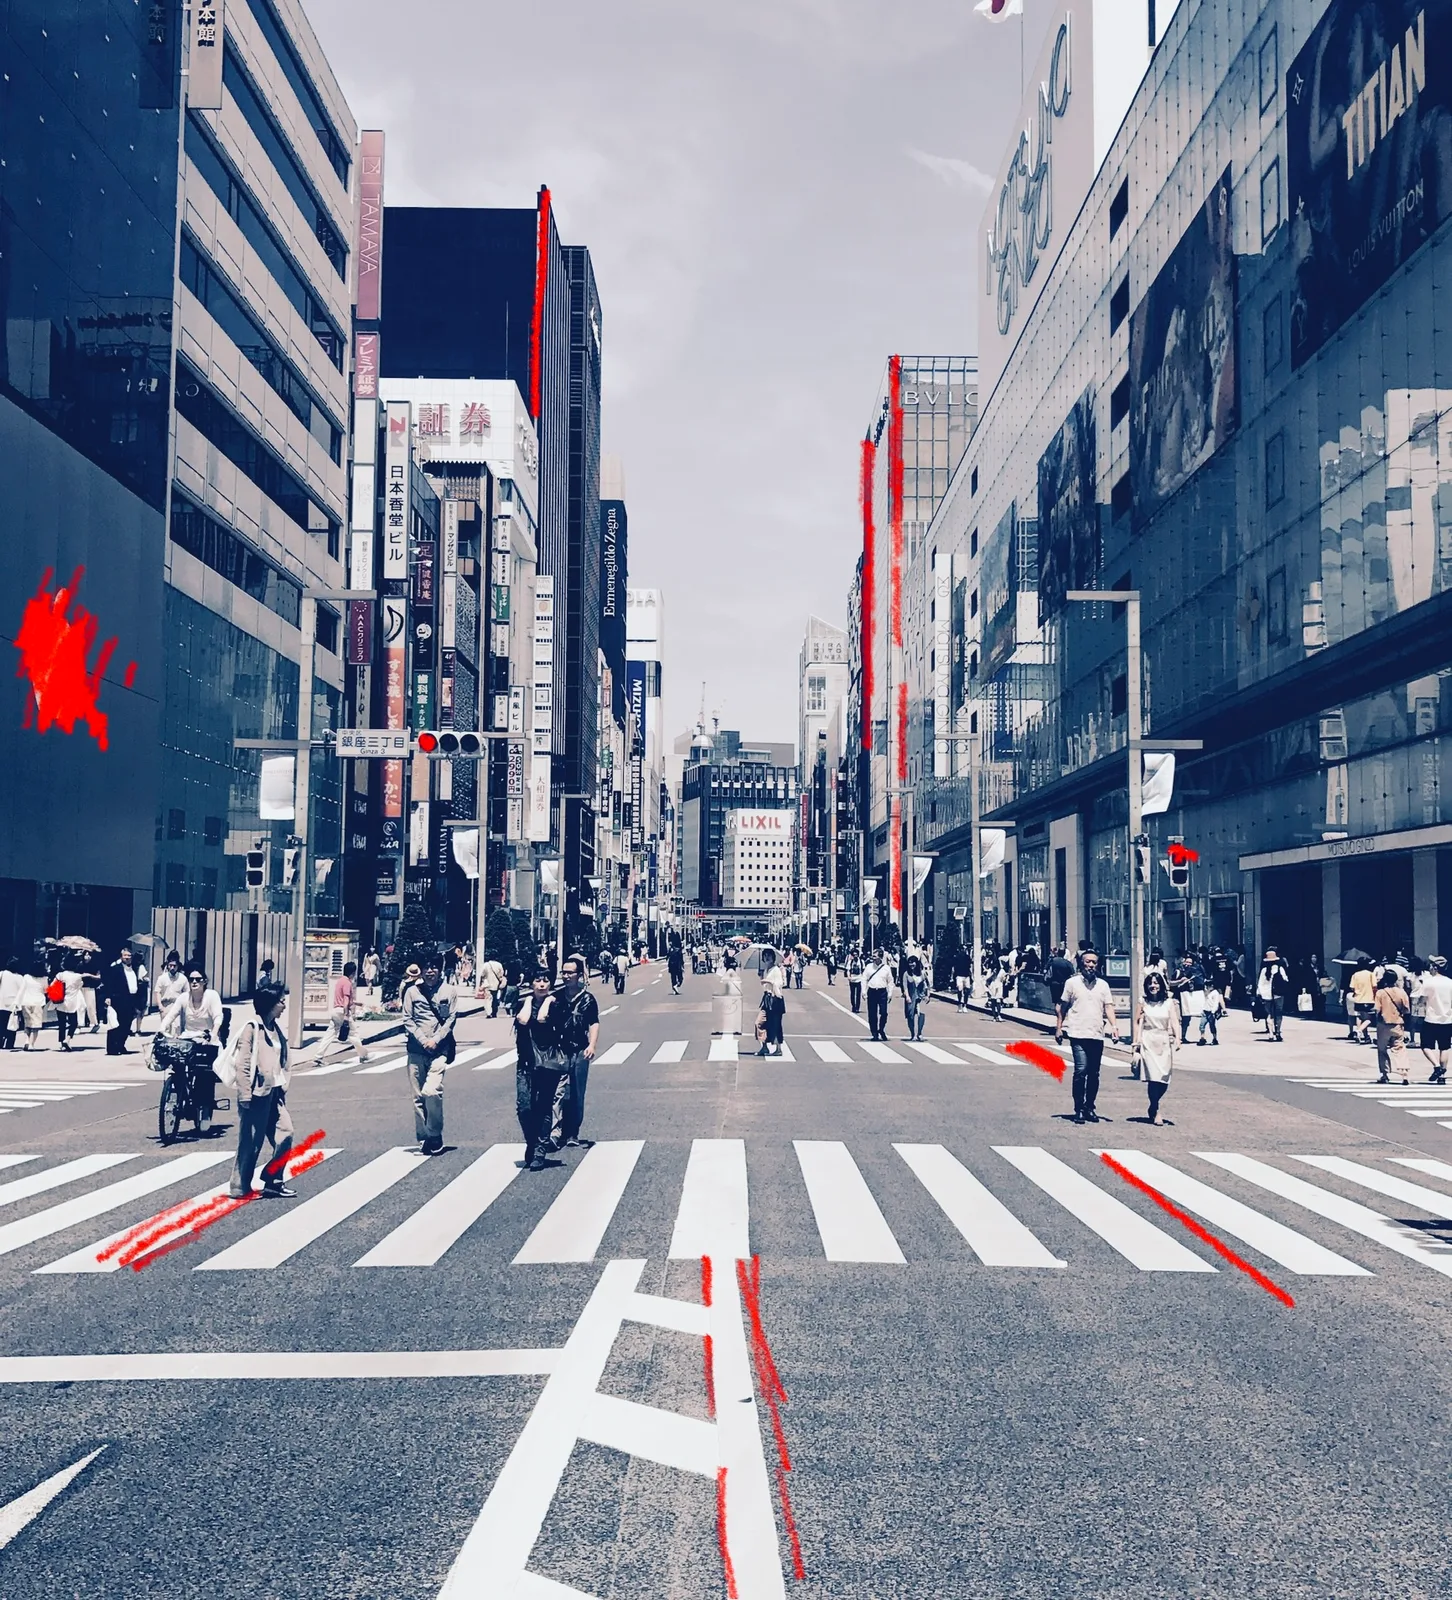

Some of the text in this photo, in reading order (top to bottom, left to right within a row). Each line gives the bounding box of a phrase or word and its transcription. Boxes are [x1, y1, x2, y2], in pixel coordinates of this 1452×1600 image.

[198, 5, 216, 41] 本館
[1342, 9, 1425, 180] TITIAN
[360, 193, 380, 276] TAMAYA
[1348, 177, 1424, 273] LOUIS VUITTON
[357, 337, 375, 395] プレミア証券
[419, 402, 491, 436] 証券
[389, 465, 404, 561] 日本香堂ビル
[603, 507, 619, 617] Ermenegildo Zegna
[341, 736, 405, 748] 銀座三丁目
[741, 815, 781, 830] LIXIL
